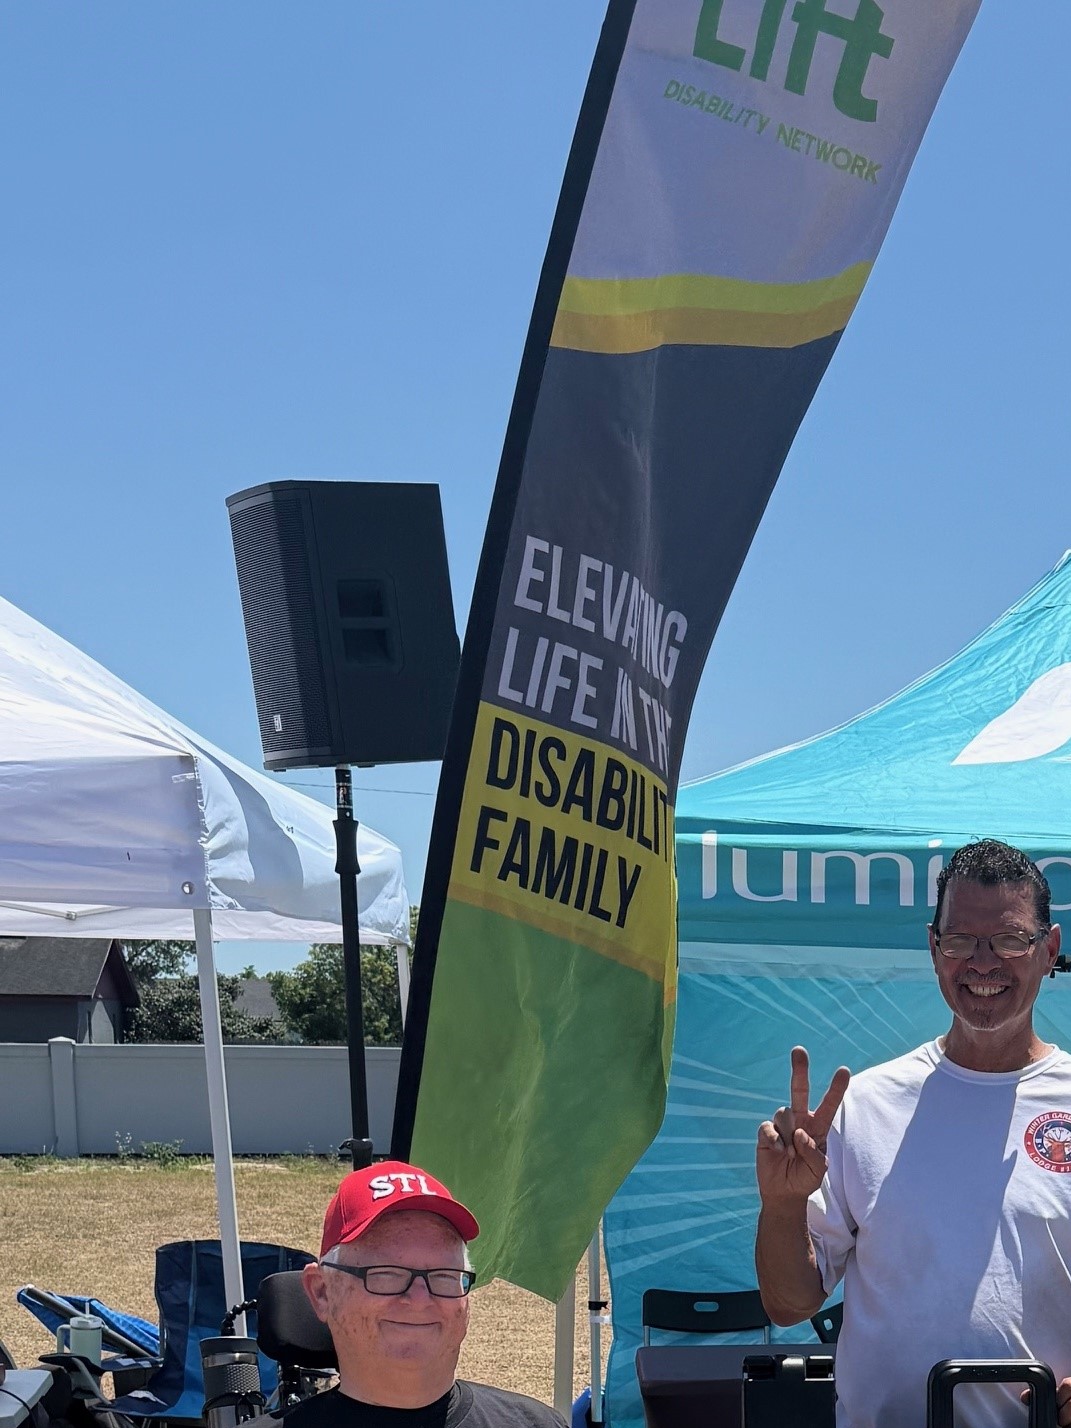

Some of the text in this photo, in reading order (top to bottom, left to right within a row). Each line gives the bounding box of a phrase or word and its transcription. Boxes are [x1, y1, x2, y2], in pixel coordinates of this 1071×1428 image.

[664, 79, 883, 185] DISABILITY NETWORK
[513, 534, 688, 689] ELEVATING
[497, 627, 604, 729] LIFE
[610, 667, 638, 751] IN
[486, 717, 668, 863] DISABILIT
[470, 806, 642, 929] FAMILY
[368, 1173, 438, 1201] STL
[1029, 1152, 1057, 1172] LODGE
